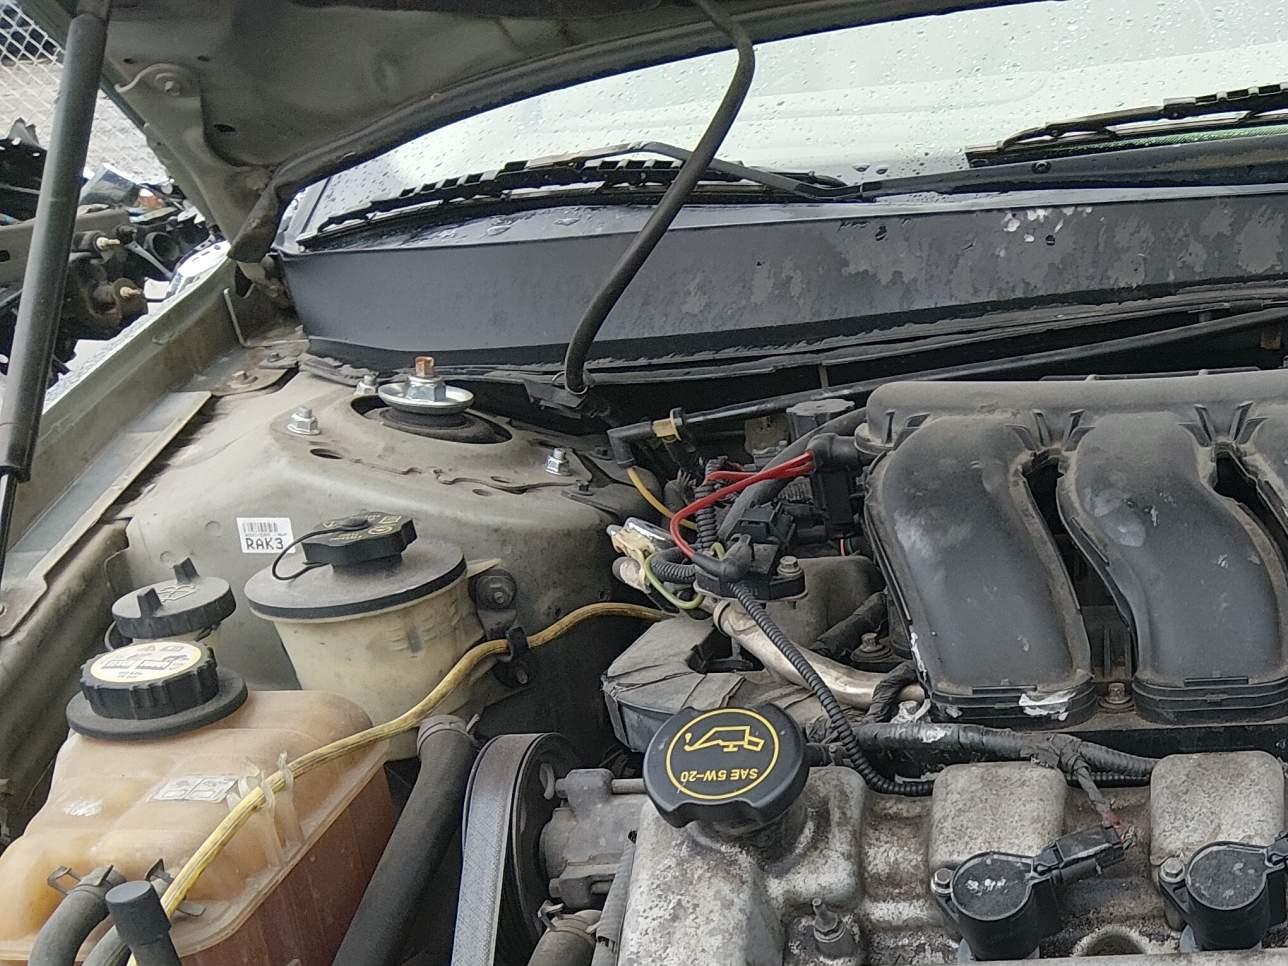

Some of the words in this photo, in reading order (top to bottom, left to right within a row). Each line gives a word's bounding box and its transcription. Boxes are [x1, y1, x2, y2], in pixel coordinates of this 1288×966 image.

[245, 538, 284, 550] RAK3
[681, 769, 726, 781] 5W-20
[730, 768, 758, 780] SAE
